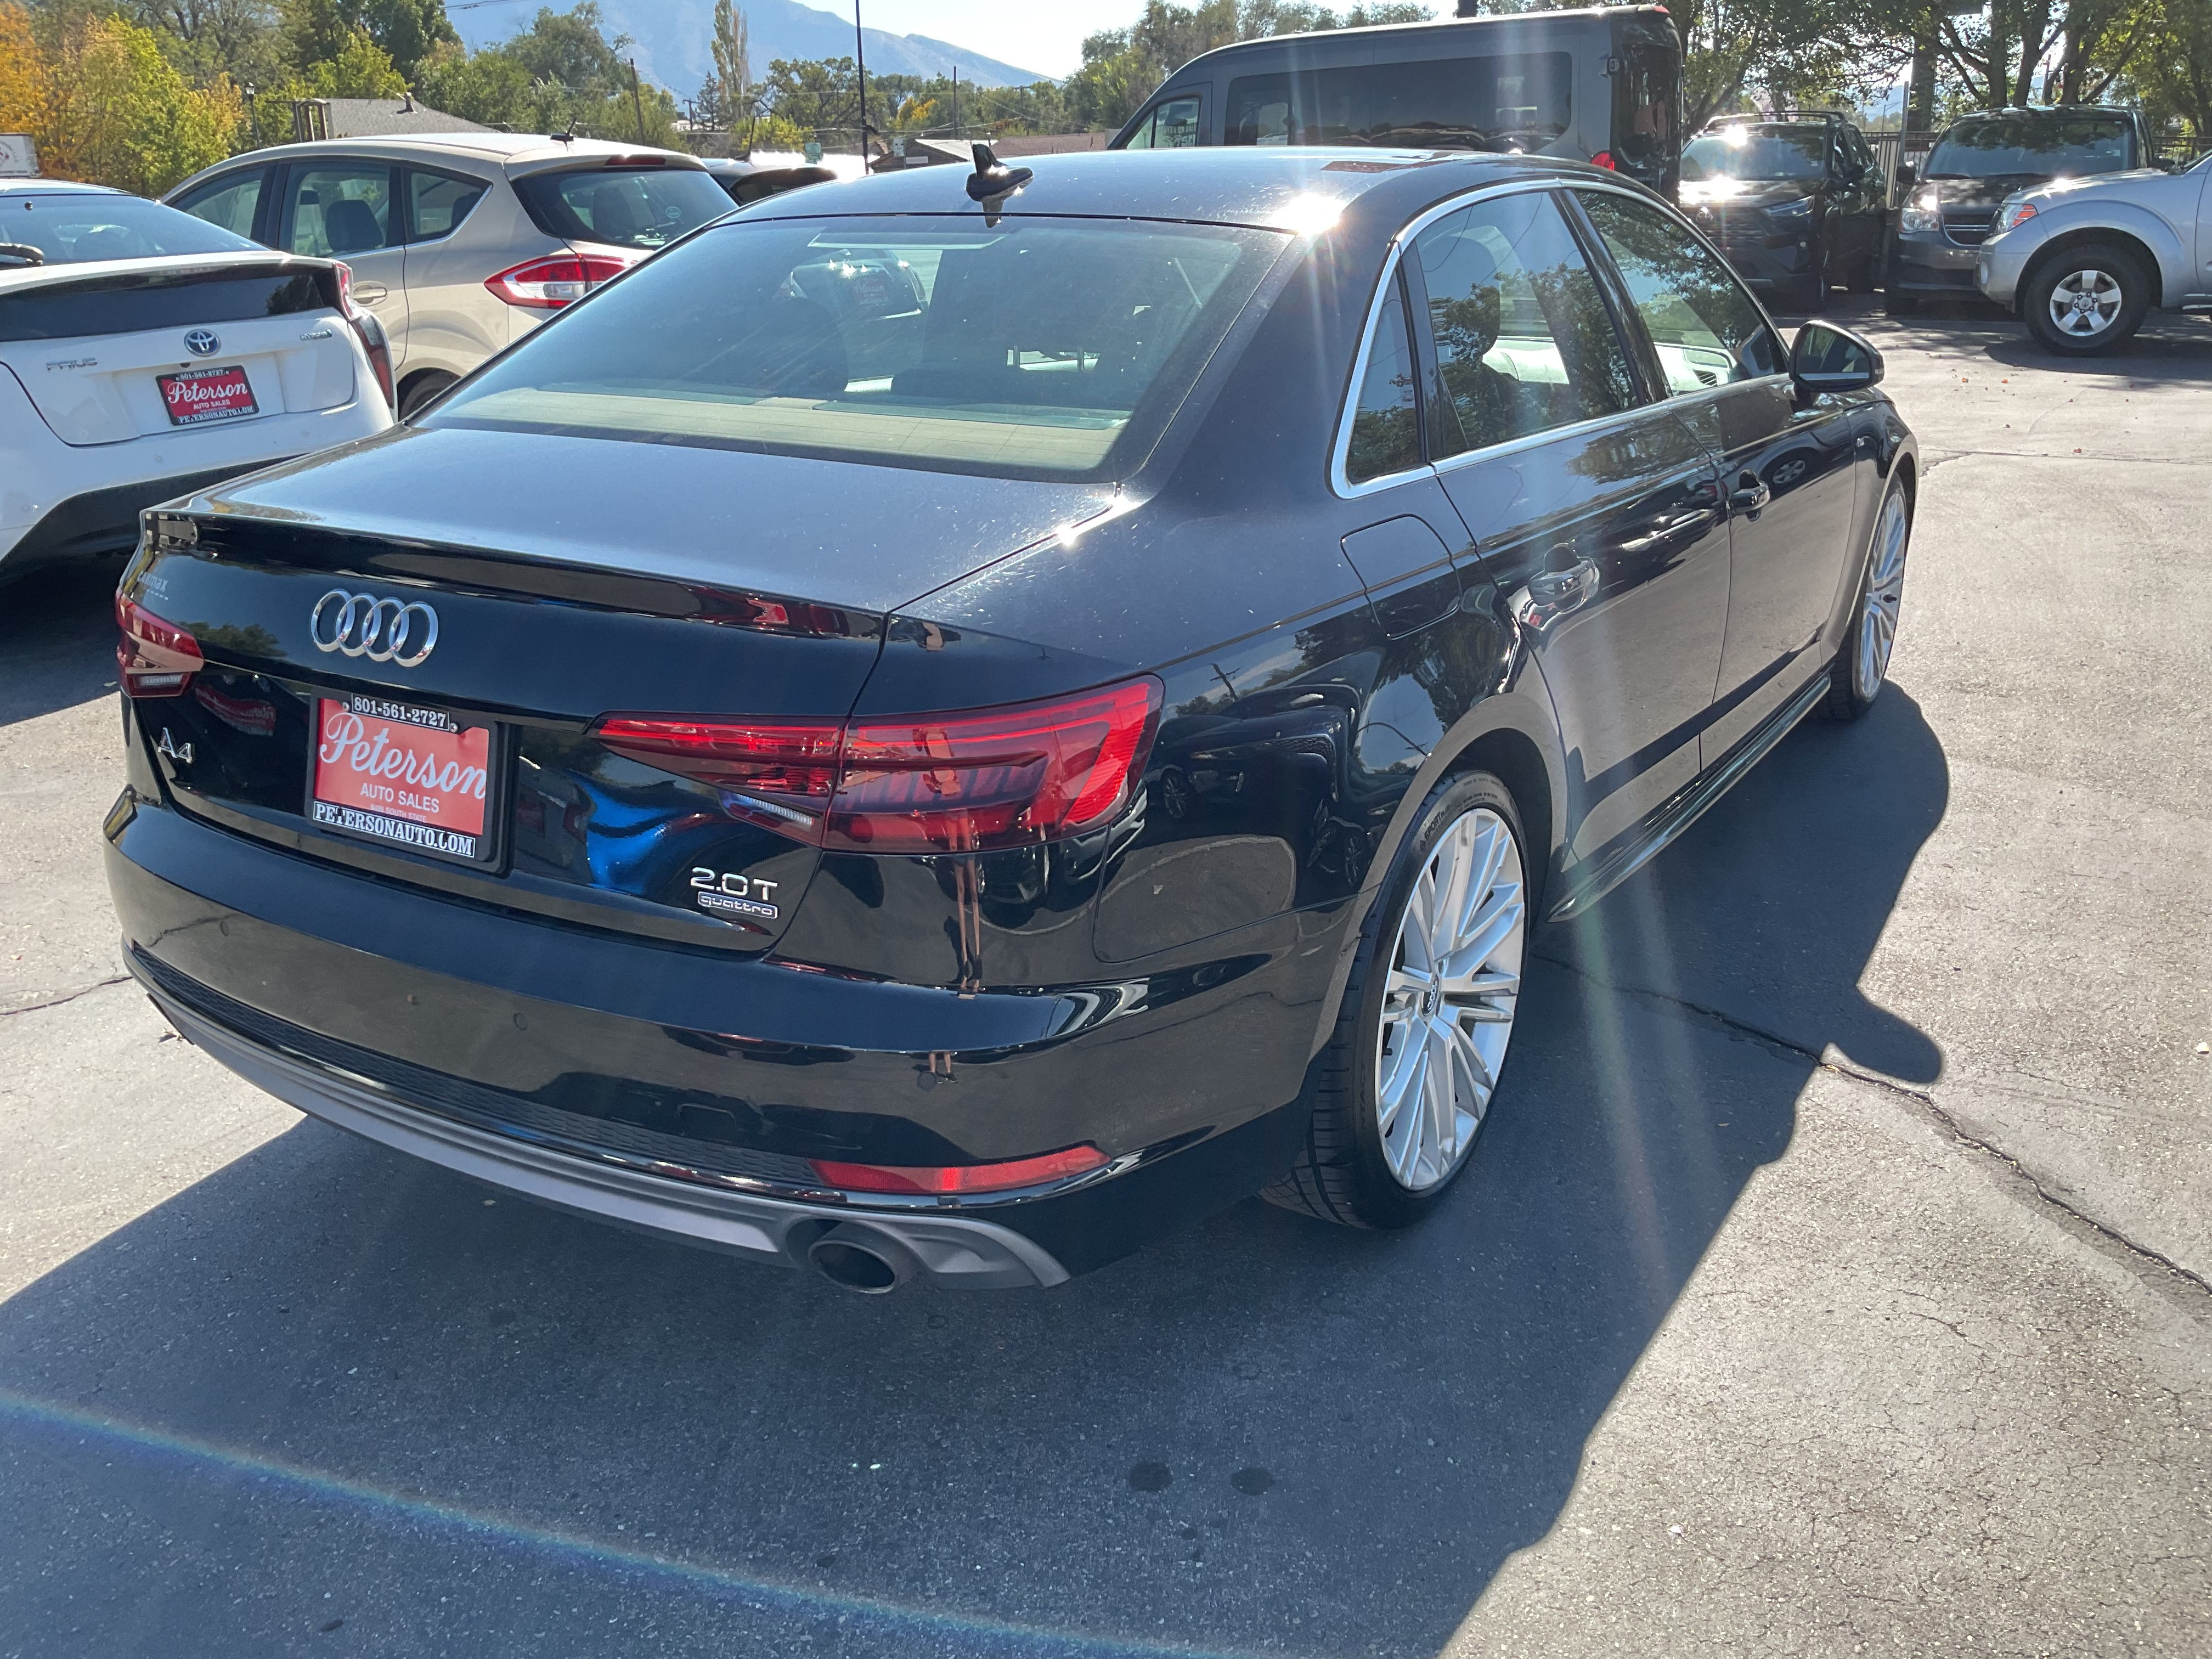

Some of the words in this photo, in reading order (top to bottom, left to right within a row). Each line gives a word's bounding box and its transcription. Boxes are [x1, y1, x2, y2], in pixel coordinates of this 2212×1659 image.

[47, 357, 98, 371] PRIUS
[180, 369, 223, 380] 801-561-2727
[167, 381, 248, 404] Peterson
[193, 402, 209, 410] AUTO
[211, 399, 230, 408] SALES
[354, 696, 446, 727] 801-561-2727
[157, 727, 194, 764] A4
[320, 712, 487, 799] Peterson
[360, 782, 394, 803] AUTO
[398, 790, 439, 813] SALES
[386, 807, 407, 819] SOUTH
[408, 812, 427, 822] STATE
[690, 866, 778, 901] 2.0T
[700, 894, 773, 916] quattro
